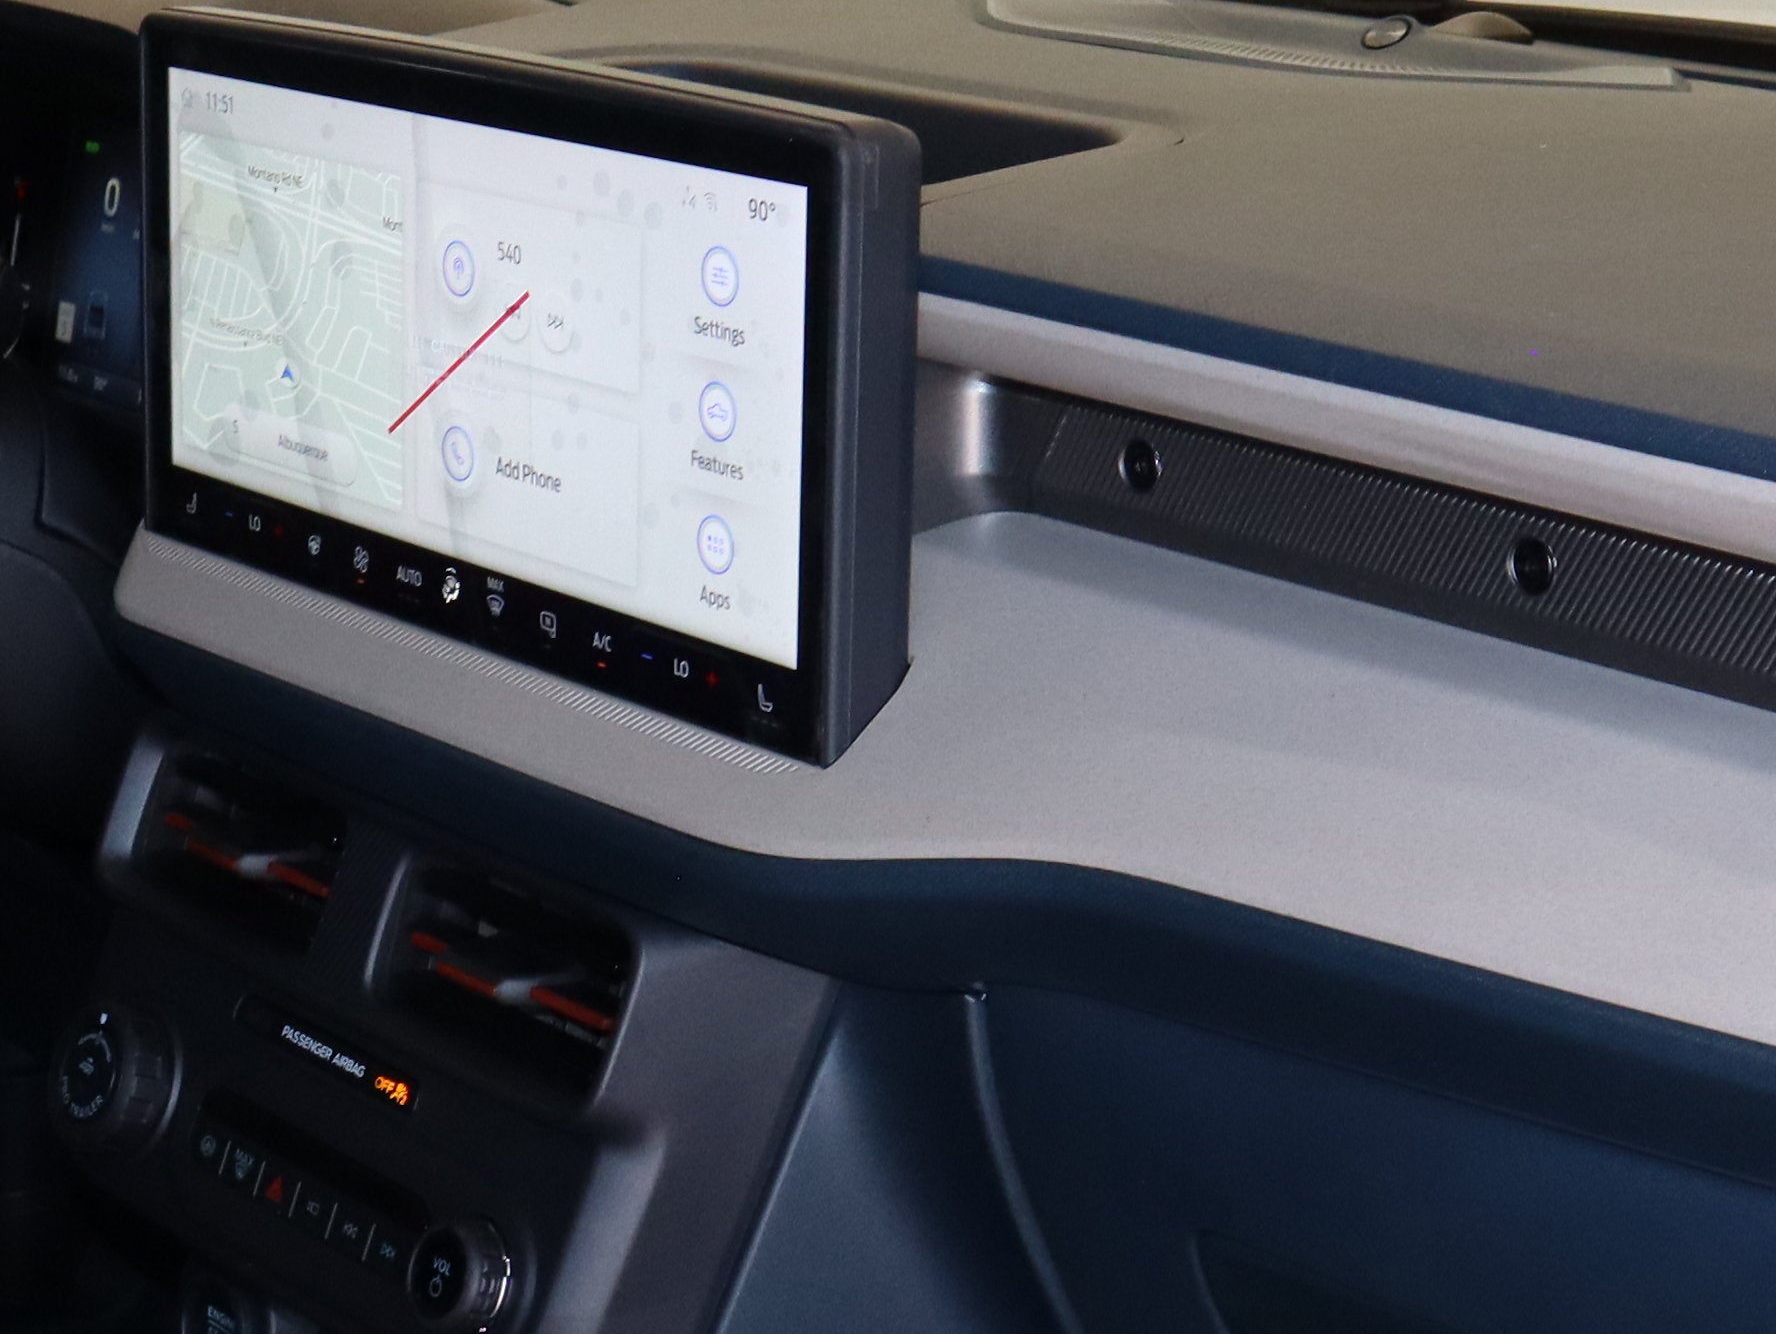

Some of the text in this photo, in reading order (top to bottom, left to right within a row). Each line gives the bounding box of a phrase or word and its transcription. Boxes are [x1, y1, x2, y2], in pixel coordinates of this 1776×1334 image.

[497, 242, 522, 265] 540
[693, 316, 746, 347] Settings
[495, 456, 562, 493] Add Phone
[690, 450, 745, 481] Features
[395, 564, 423, 588] AUTO
[699, 584, 731, 611] Apps
[592, 631, 613, 653] A/C
[281, 1024, 396, 1094] PASSENGER AIRBAG OFF
